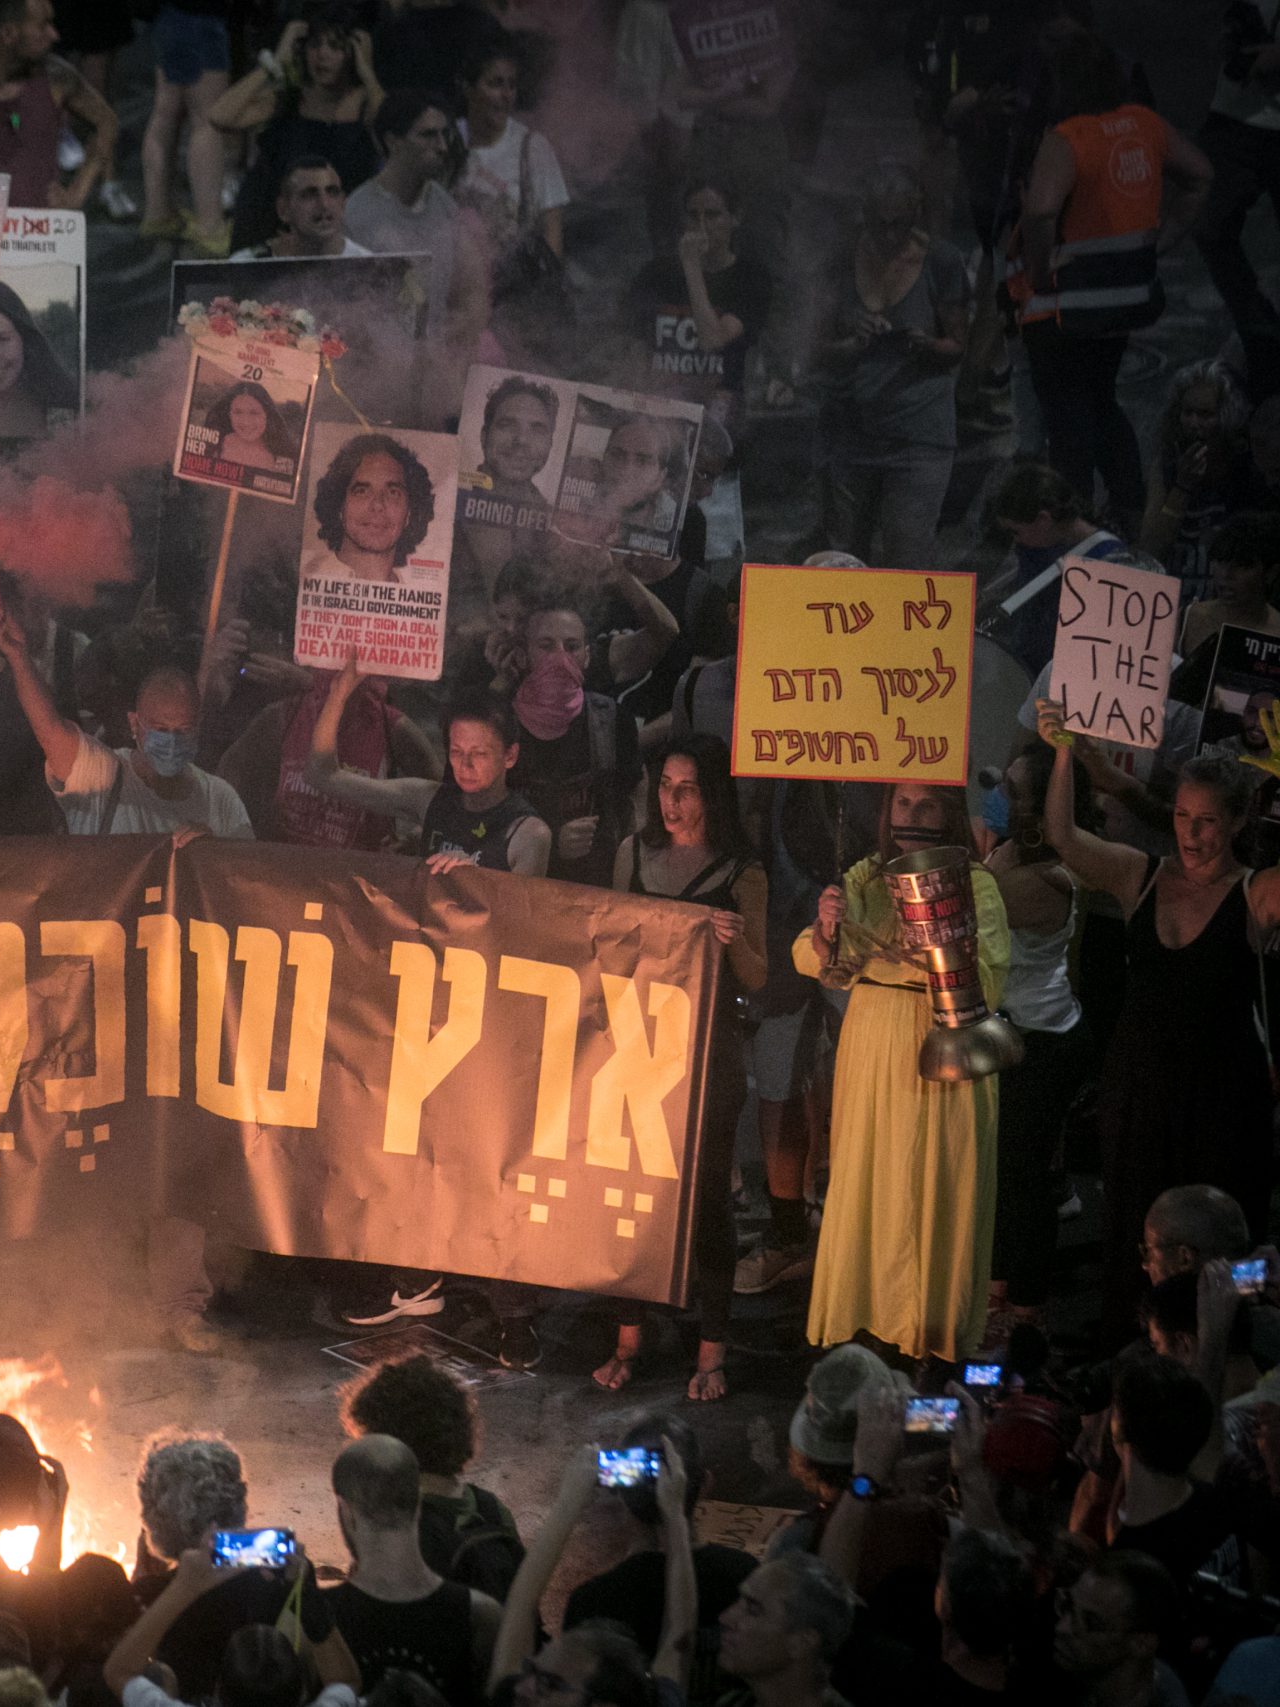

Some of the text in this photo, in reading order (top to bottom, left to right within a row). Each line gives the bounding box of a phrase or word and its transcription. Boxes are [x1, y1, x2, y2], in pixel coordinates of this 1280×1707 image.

[53, 218, 76, 234] 20
[241, 363, 263, 382] 20
[185, 438, 207, 456] HER
[187, 424, 220, 444] BRING
[183, 454, 212, 473] HOME
[562, 476, 597, 497] BRING
[464, 497, 514, 526] BRING
[303, 577, 442, 606] MY LIFE IS IN THE HANDS
[324, 596, 366, 613] ISRAELI
[367, 601, 441, 620] GOVERNMENT
[806, 578, 952, 635] לא עוד
[1058, 566, 1173, 651] STOP
[301, 609, 439, 636] IF THEY DON'T SIGN A DEAL
[301, 623, 439, 652] THEY ARE SIGNING MY
[1240, 636, 1254, 653] חי
[298, 639, 438, 670] DEATH WARRANT!
[1071, 635, 1160, 691] THE
[764, 648, 957, 715] לניסוך הדם
[1061, 683, 1158, 744] WAR
[751, 718, 949, 768] של החטופים
